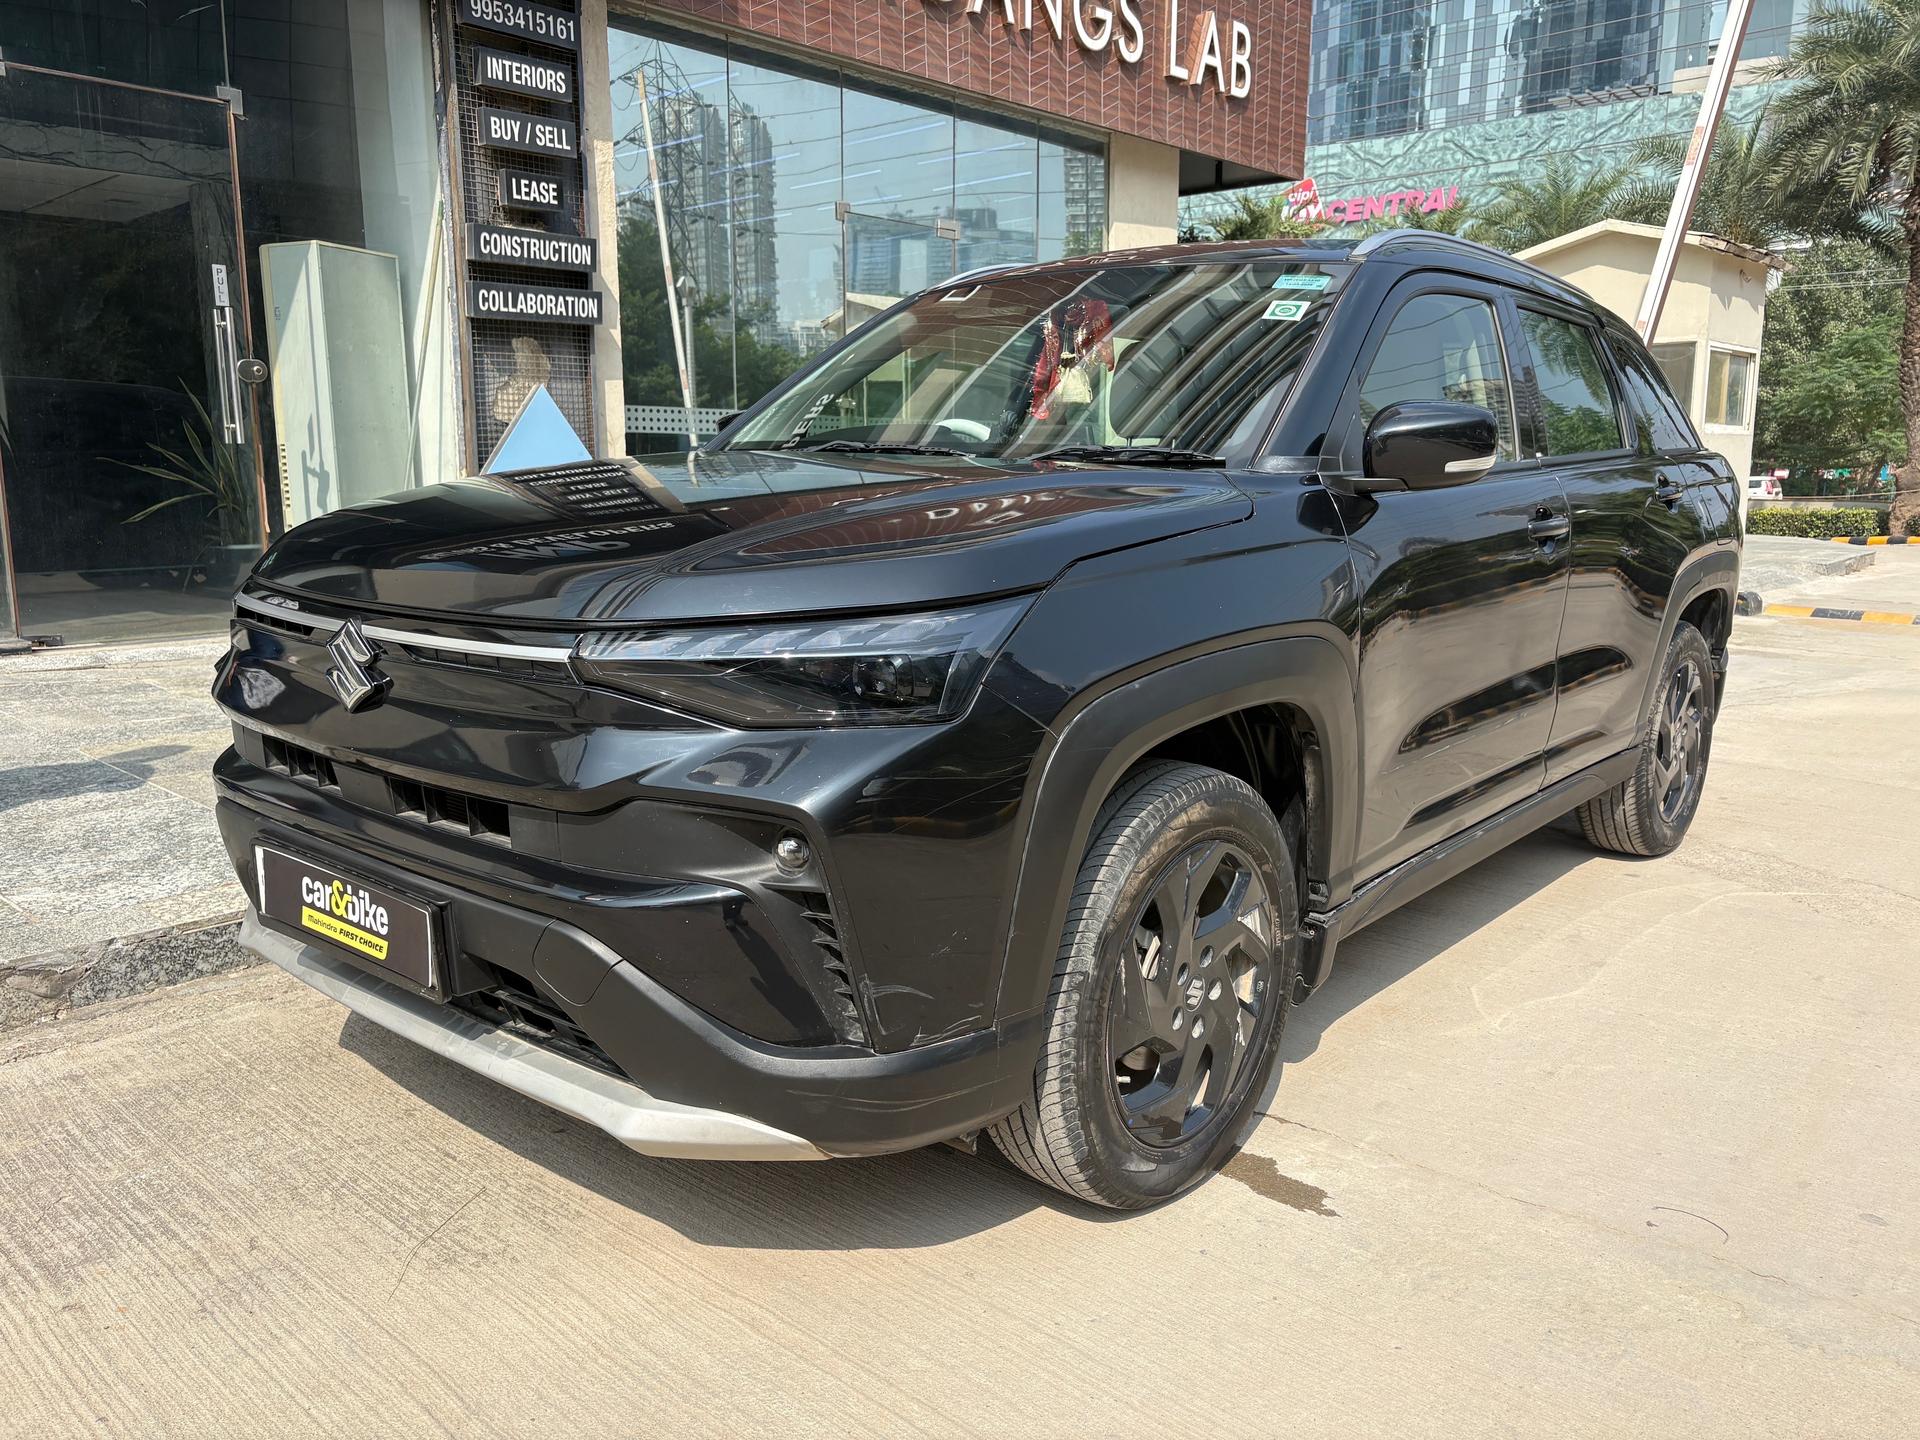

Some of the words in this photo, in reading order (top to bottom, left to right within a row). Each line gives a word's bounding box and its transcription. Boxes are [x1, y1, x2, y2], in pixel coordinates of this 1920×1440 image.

[1163, 0, 1252, 99] LAB
[486, 56, 566, 94] INTERIORS
[490, 115, 520, 143] BUY
[535, 124, 571, 150] SELL
[511, 177, 558, 205] LEASE
[480, 232, 592, 266] CONSTRUCTION
[216, 268, 225, 303] PULL
[477, 289, 598, 319] COLLABORATION
[302, 876, 389, 935] car&bike
[339, 928, 358, 942] FIRST
[358, 936, 384, 953] CHOICE
